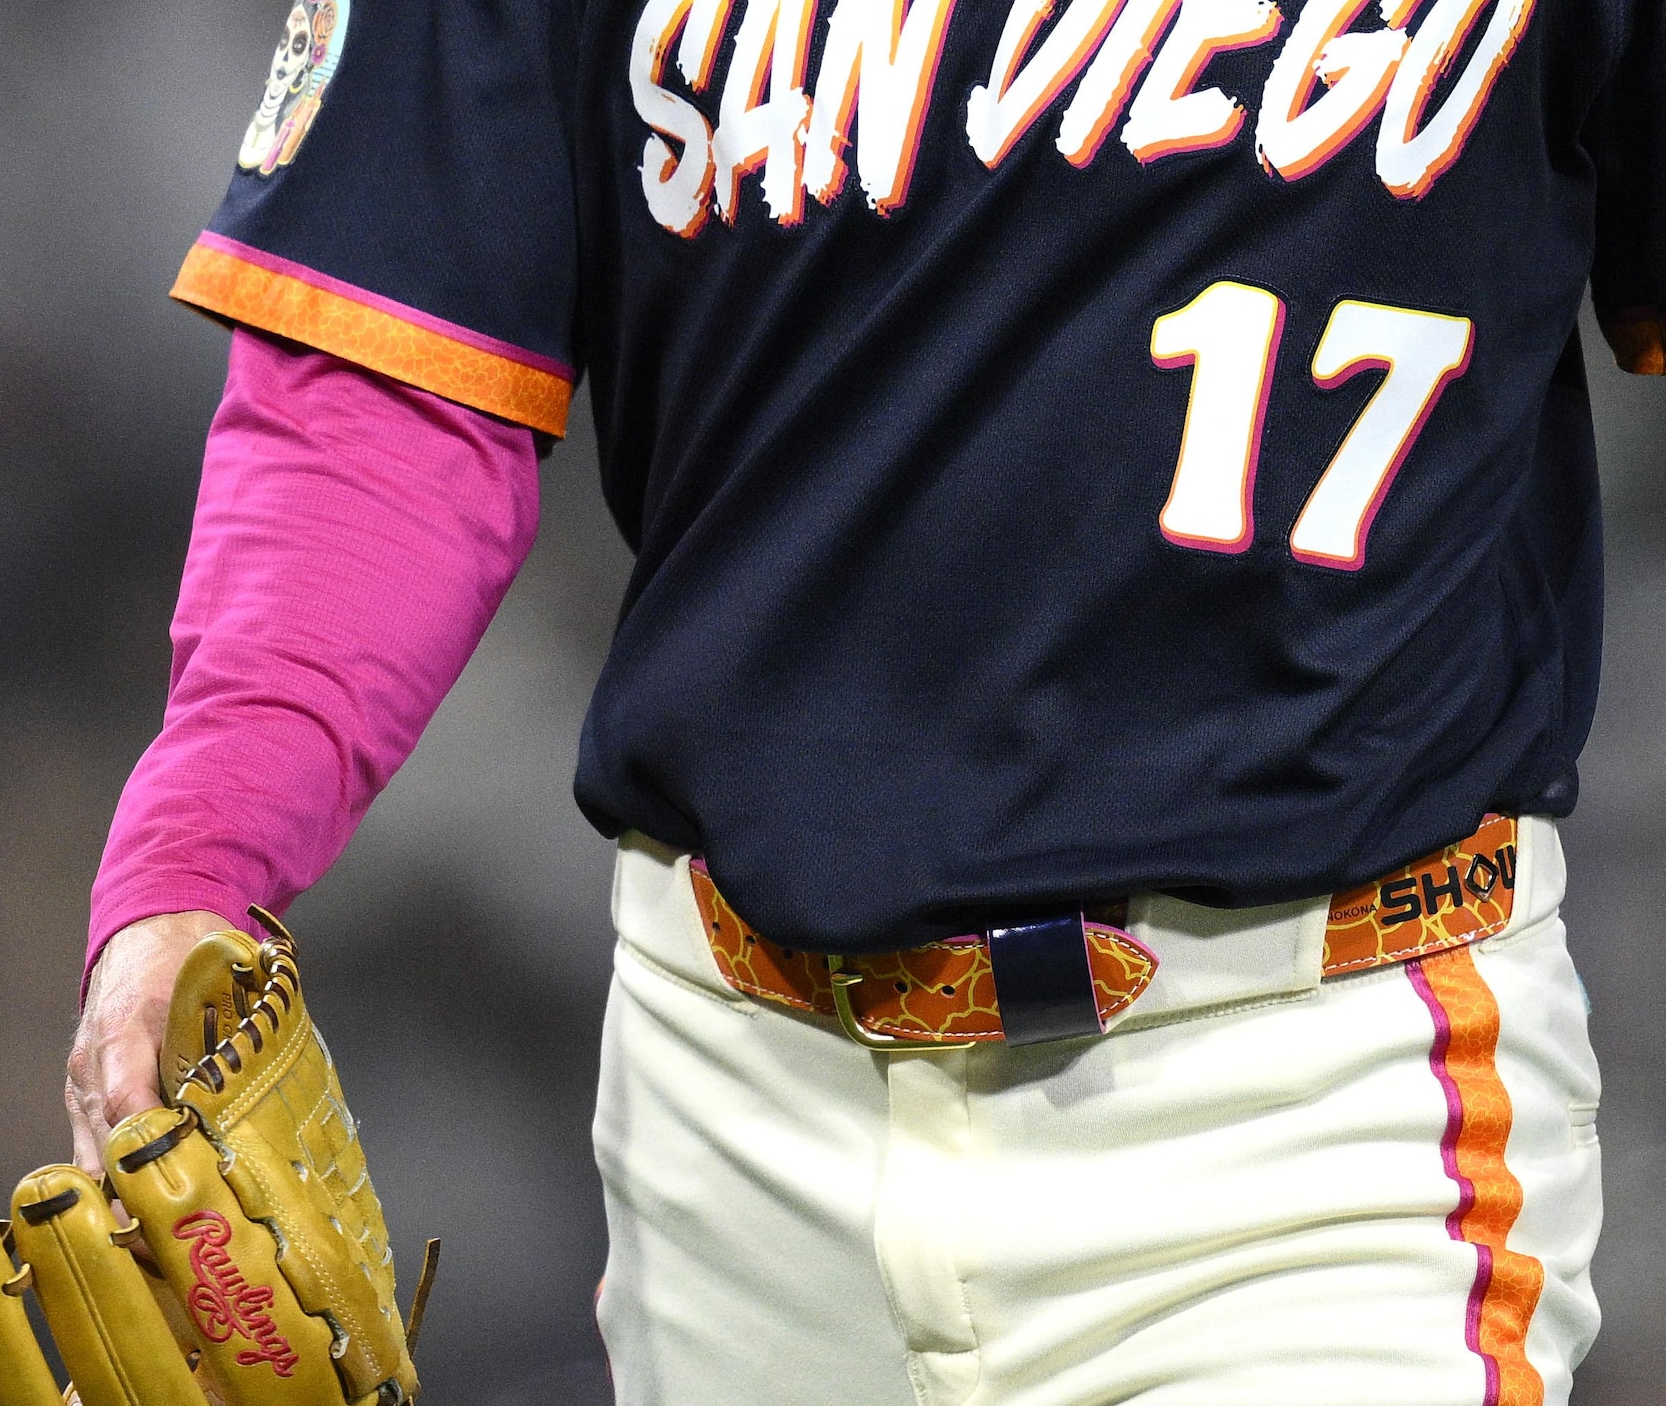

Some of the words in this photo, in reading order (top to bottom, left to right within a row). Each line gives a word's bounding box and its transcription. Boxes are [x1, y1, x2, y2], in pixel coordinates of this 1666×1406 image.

[1149, 280, 1476, 572] 17
[222, 992, 233, 1020] PRO
[172, 1209, 300, 1377] Rawlings
